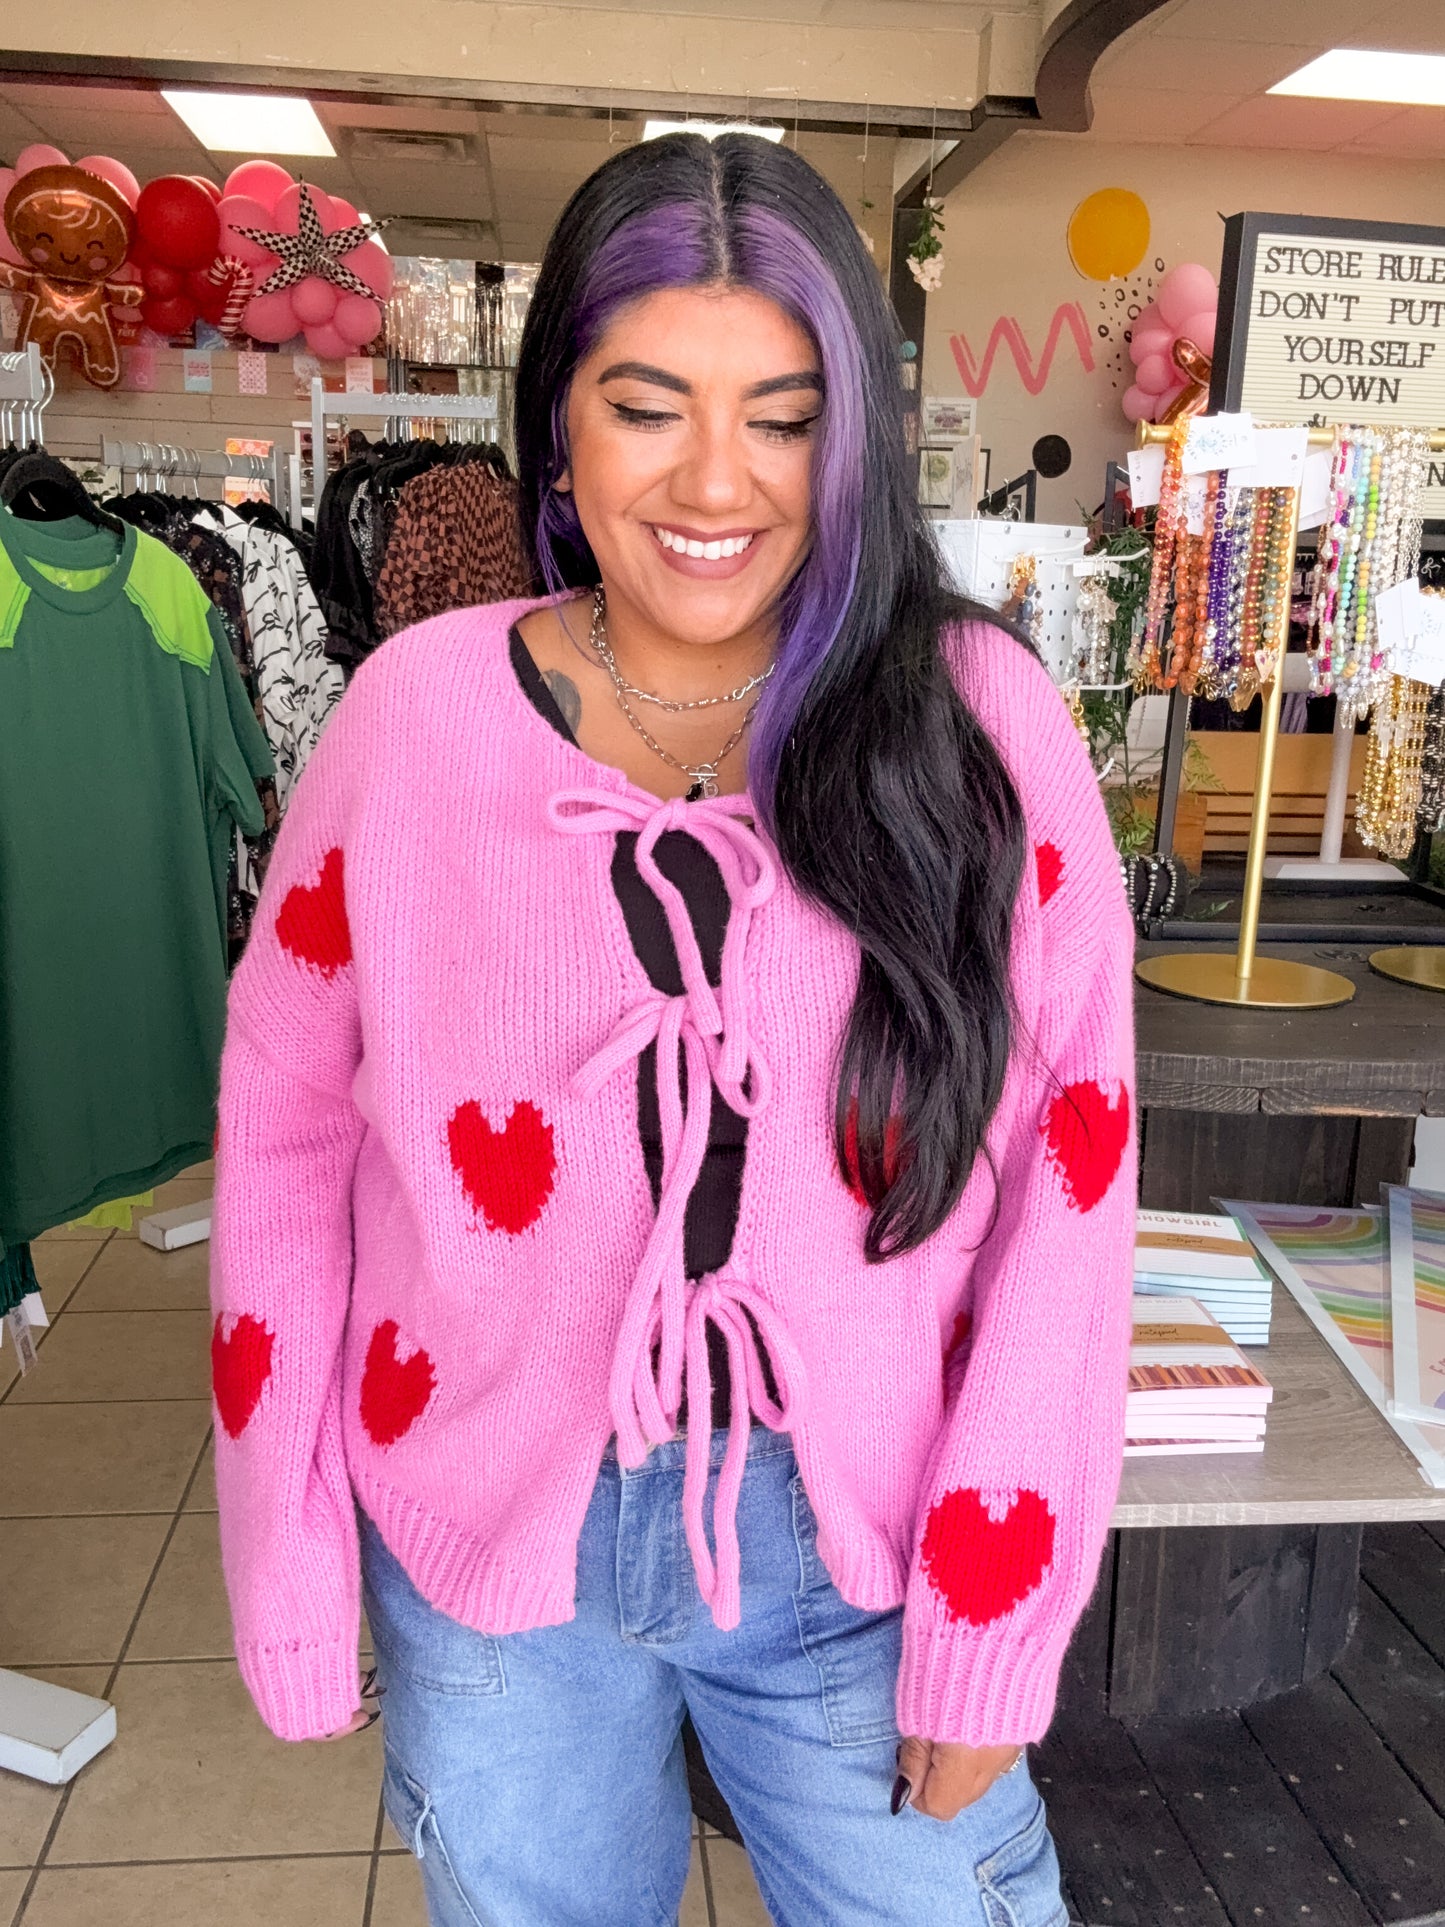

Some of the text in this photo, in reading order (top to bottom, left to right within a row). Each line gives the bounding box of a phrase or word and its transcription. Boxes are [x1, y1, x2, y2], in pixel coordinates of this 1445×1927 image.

[1264, 246, 1445, 284] STORE RULE
[1257, 290, 1445, 327] DON'T PUT
[1283, 335, 1436, 368] YOURSELF
[1297, 373, 1402, 404] DOWN
